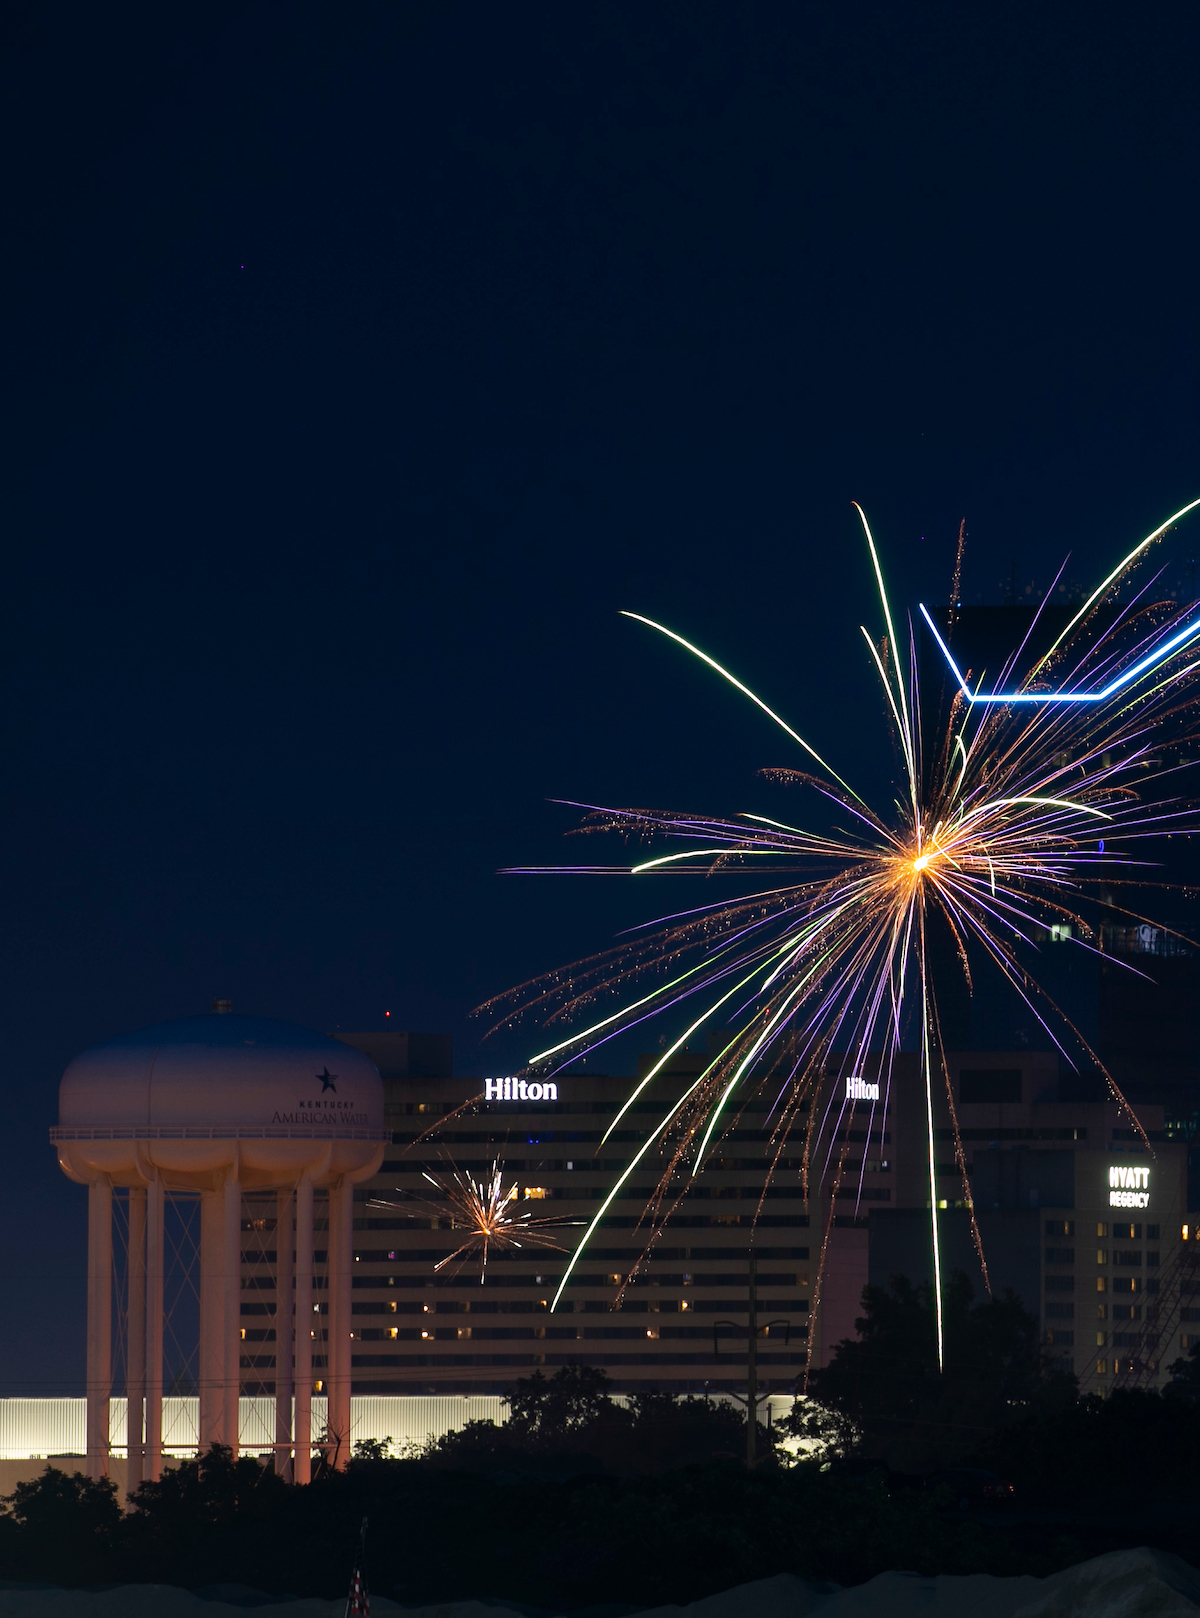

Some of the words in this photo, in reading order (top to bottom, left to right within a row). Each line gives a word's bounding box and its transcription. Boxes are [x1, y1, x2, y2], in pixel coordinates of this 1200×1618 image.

[484, 1077, 558, 1101] Hilton
[846, 1076, 880, 1100] Hilton
[299, 1100, 355, 1109] KENTUCKY
[271, 1111, 338, 1124] AMERICAN
[1109, 1166, 1150, 1189] HYATT
[1109, 1190, 1150, 1208] REGENCY
